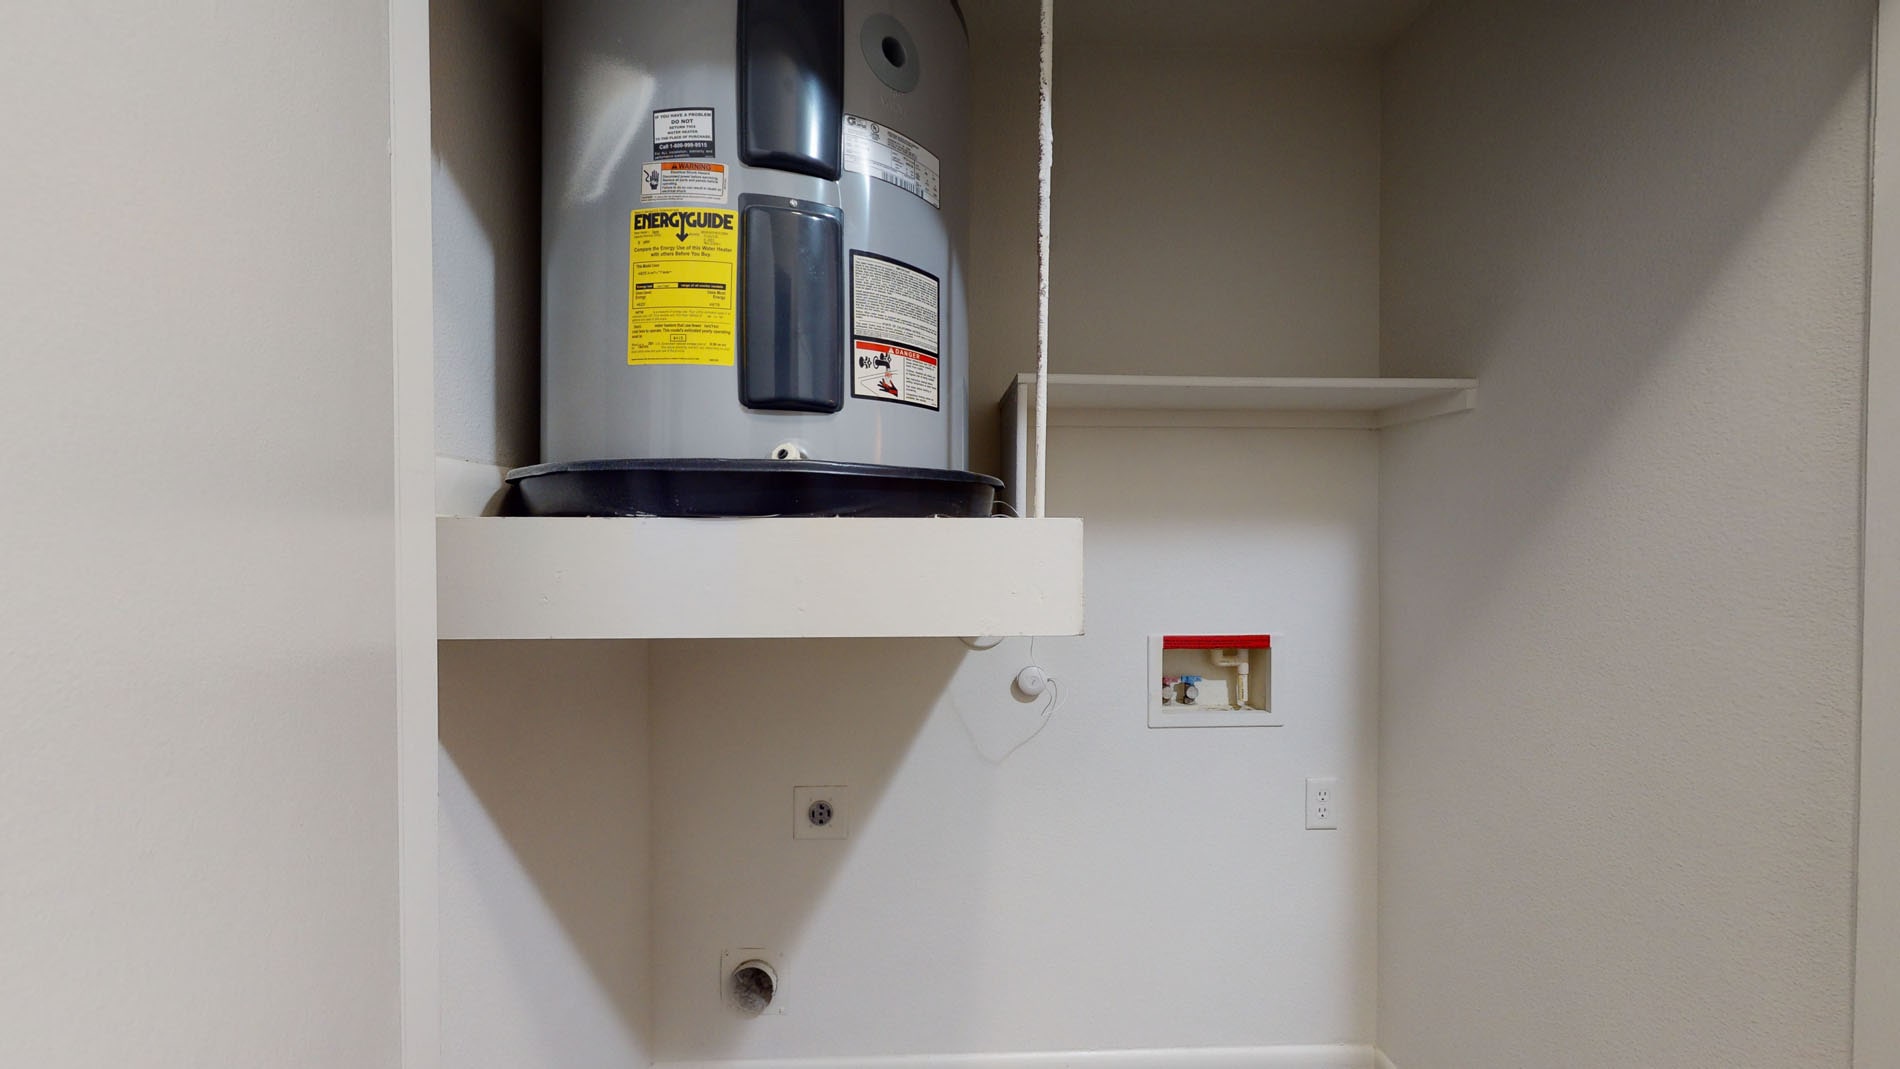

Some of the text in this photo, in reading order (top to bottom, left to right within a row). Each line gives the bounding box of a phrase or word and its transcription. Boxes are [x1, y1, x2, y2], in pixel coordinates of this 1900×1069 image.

[678, 162, 711, 170] WARNING
[634, 212, 734, 230] ENERGYGUIDE
[895, 348, 921, 359] DANGER
